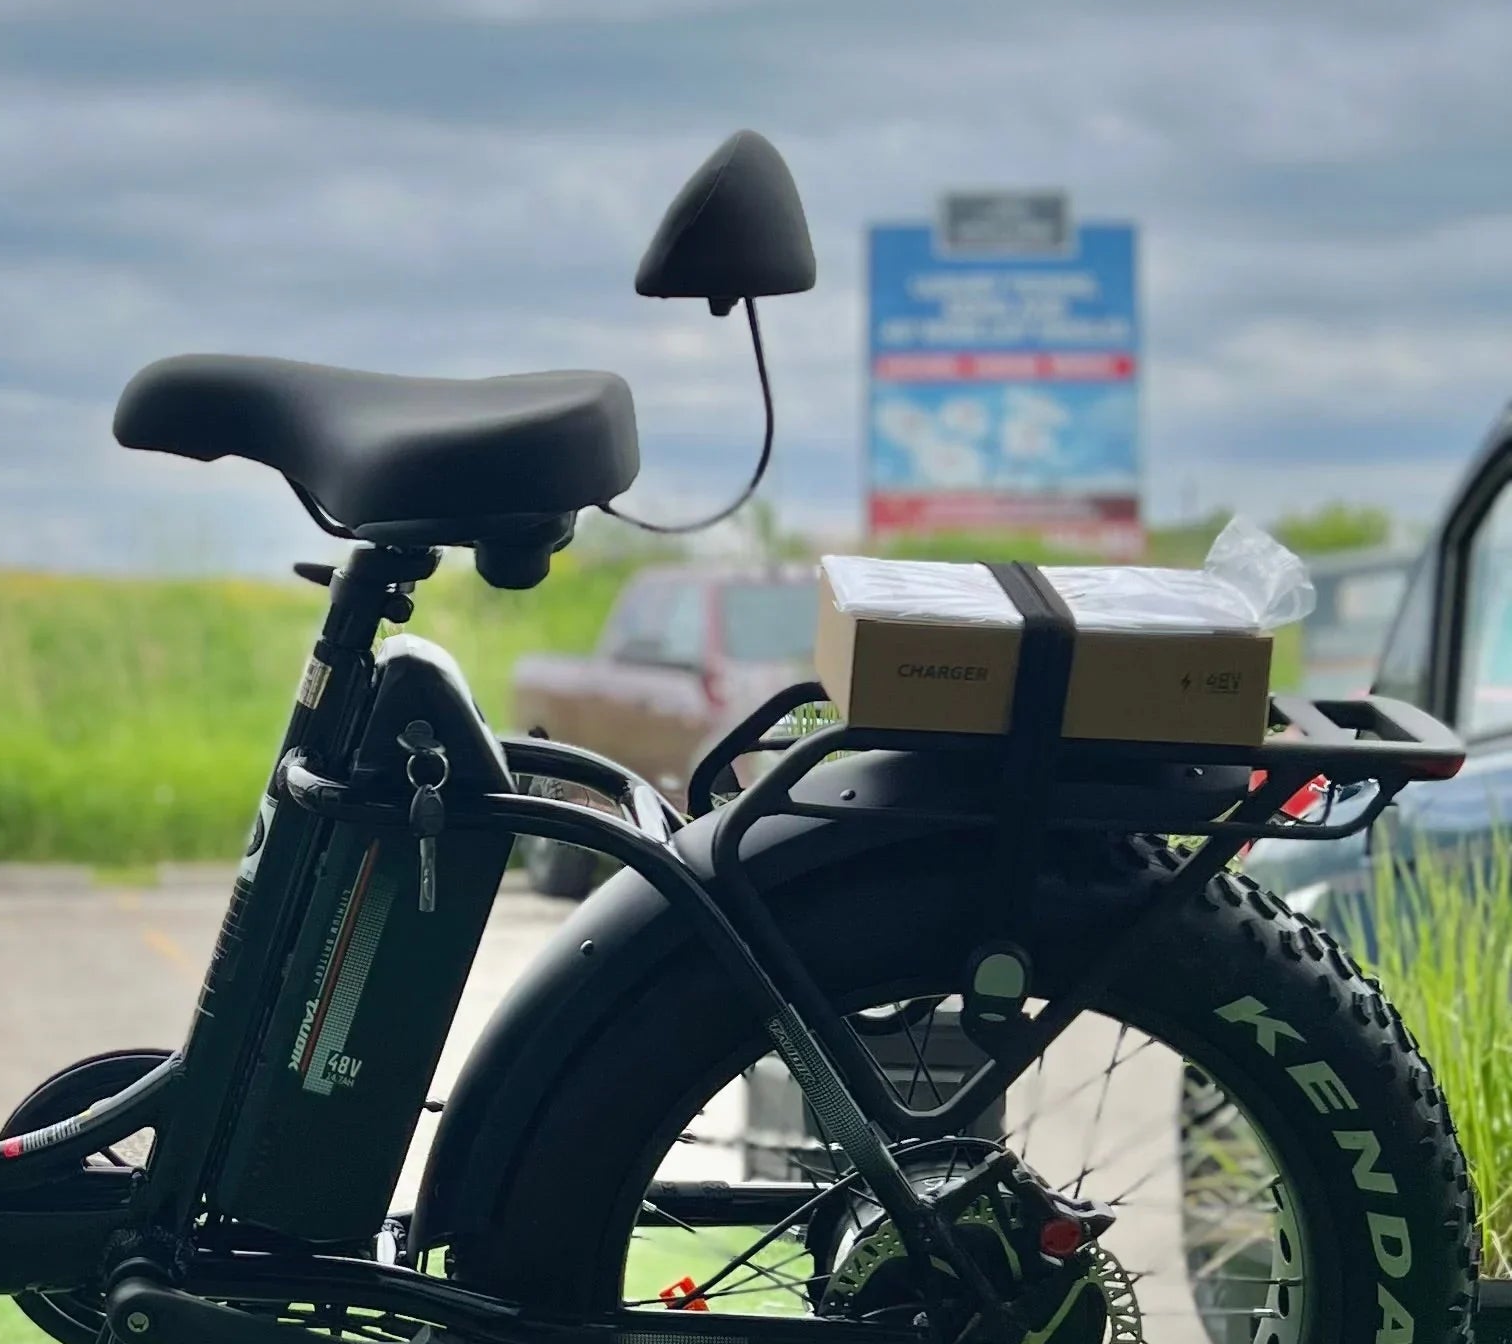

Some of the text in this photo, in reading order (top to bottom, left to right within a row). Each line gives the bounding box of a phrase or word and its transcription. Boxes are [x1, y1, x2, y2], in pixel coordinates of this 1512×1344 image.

[897, 662, 988, 682] CHARGER
[313, 889, 351, 985] LITHIUM BATTERY
[288, 999, 320, 1072] TAUBIK
[328, 1053, 362, 1077] 48V
